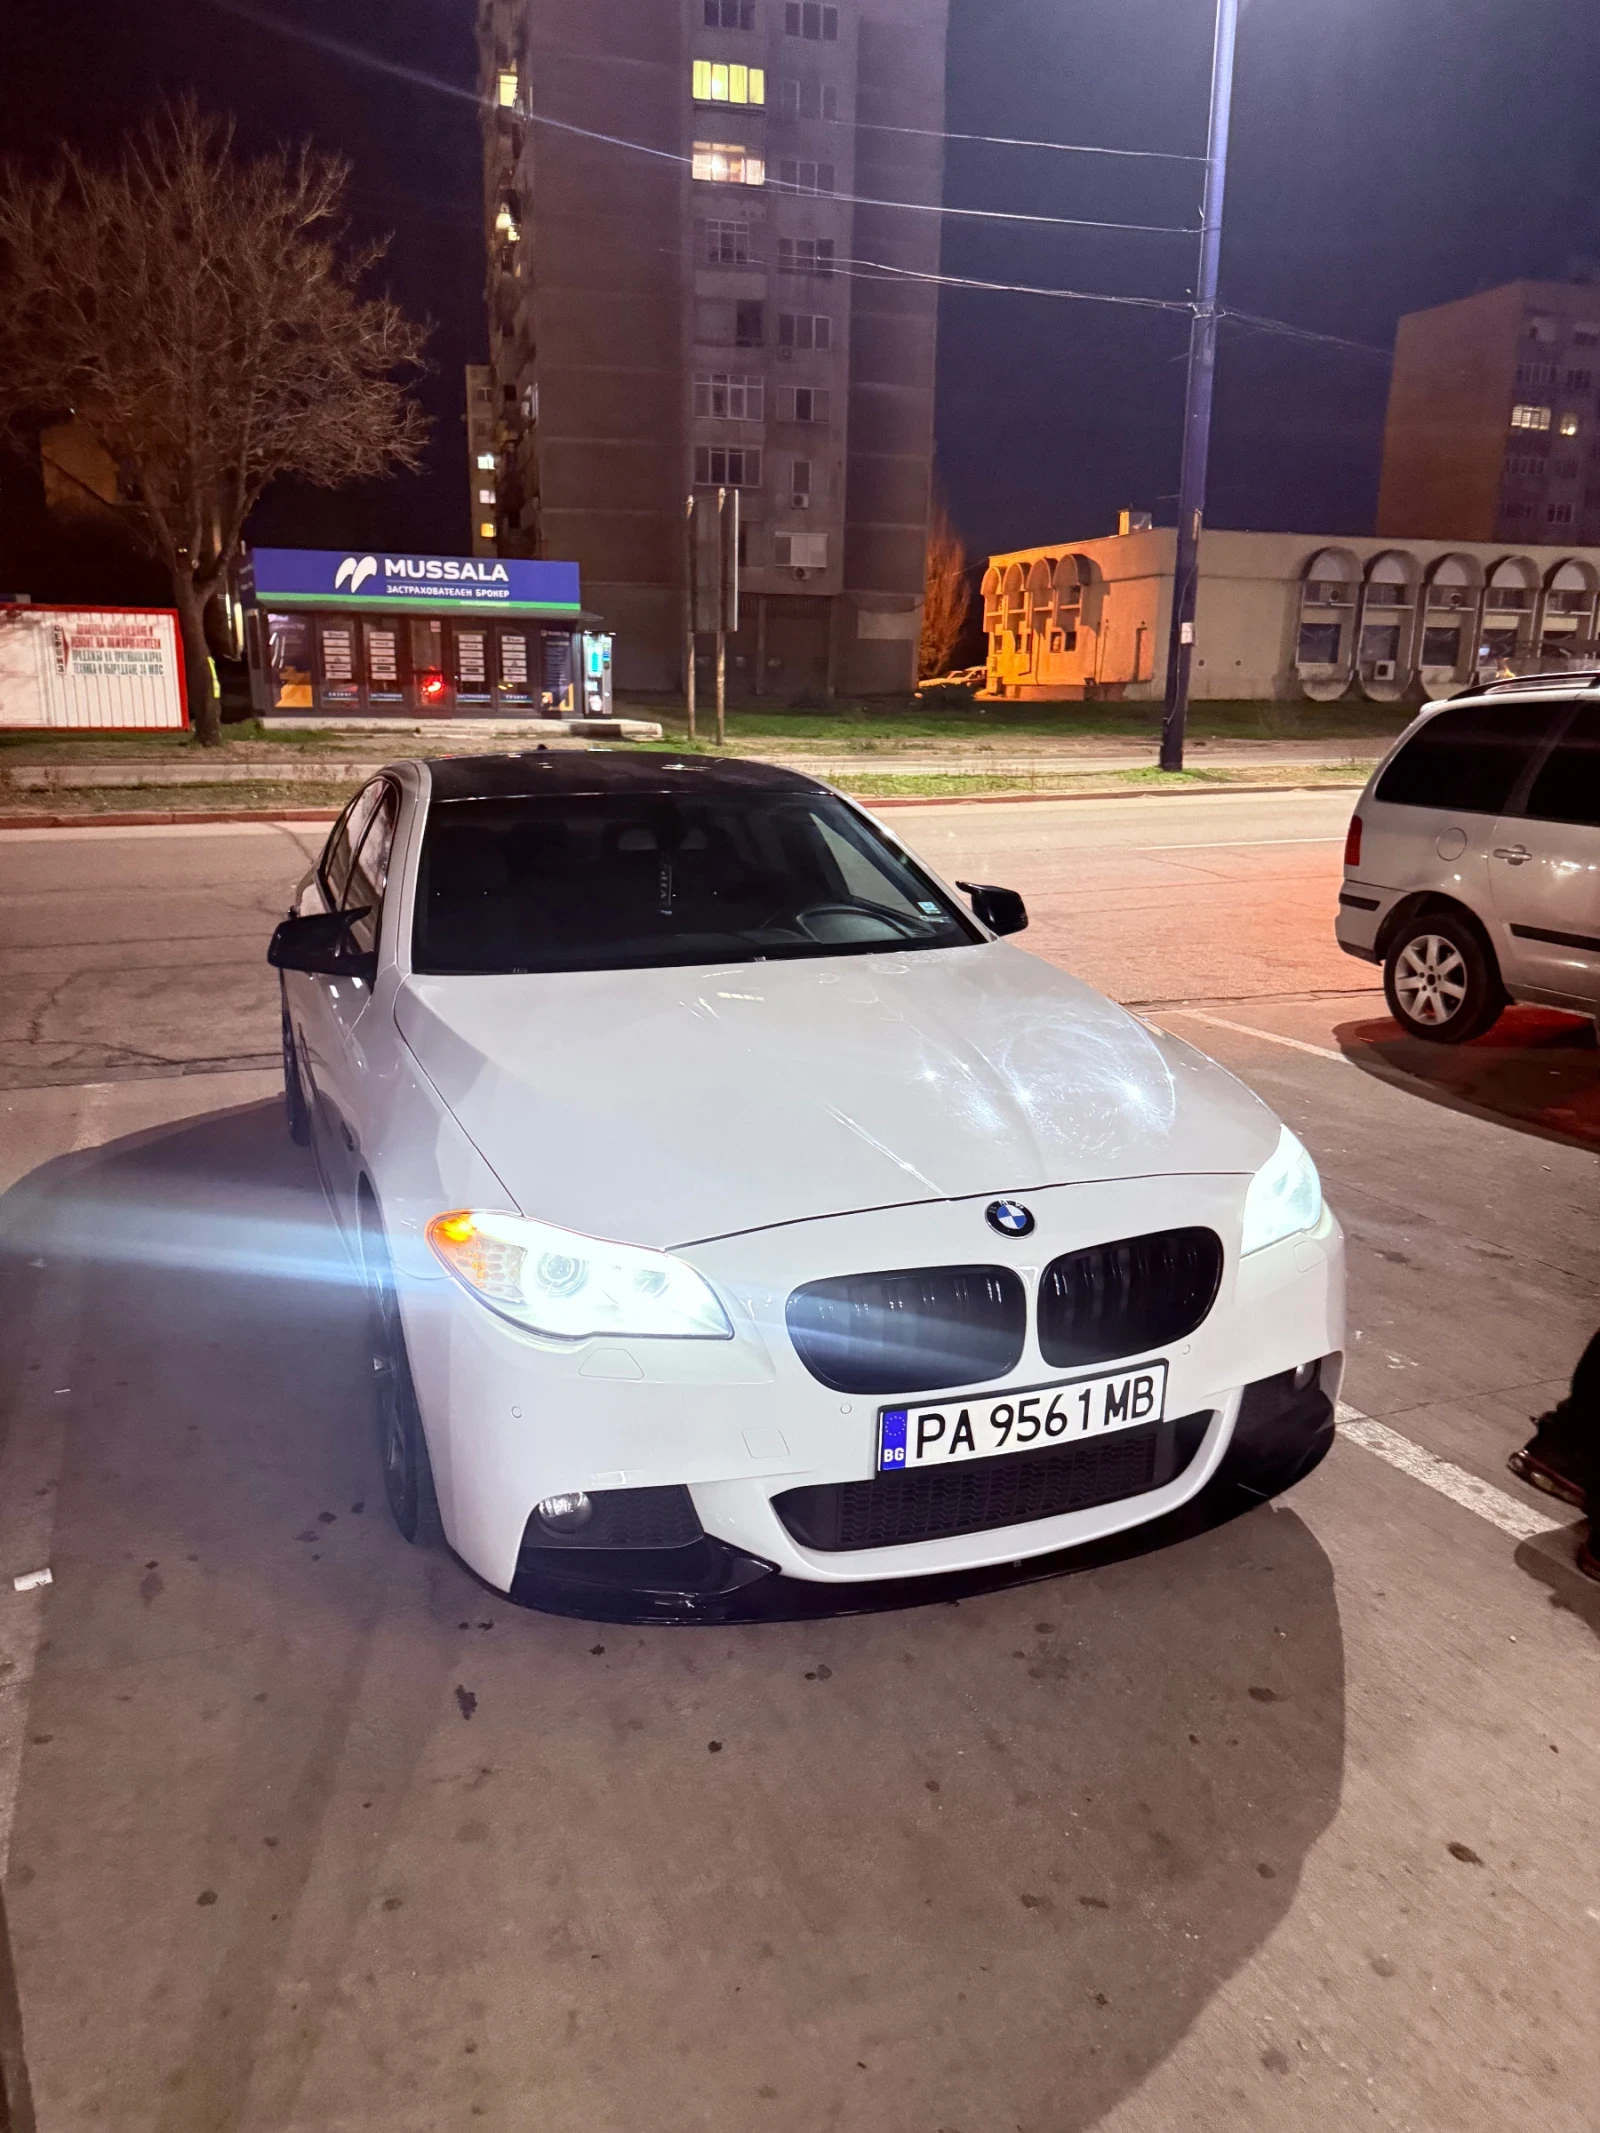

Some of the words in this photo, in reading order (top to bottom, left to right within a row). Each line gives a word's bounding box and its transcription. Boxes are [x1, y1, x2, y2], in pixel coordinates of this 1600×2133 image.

[384, 558, 509, 582] MUSSALA
[386, 584, 472, 597] ЗАСТРАХОВАТЕЛЕН
[475, 585, 510, 598] БРОКЕР
[916, 1408, 976, 1459] PA
[990, 1387, 1091, 1448] 9561
[1103, 1375, 1154, 1426] MB
[883, 1447, 905, 1463] BG
